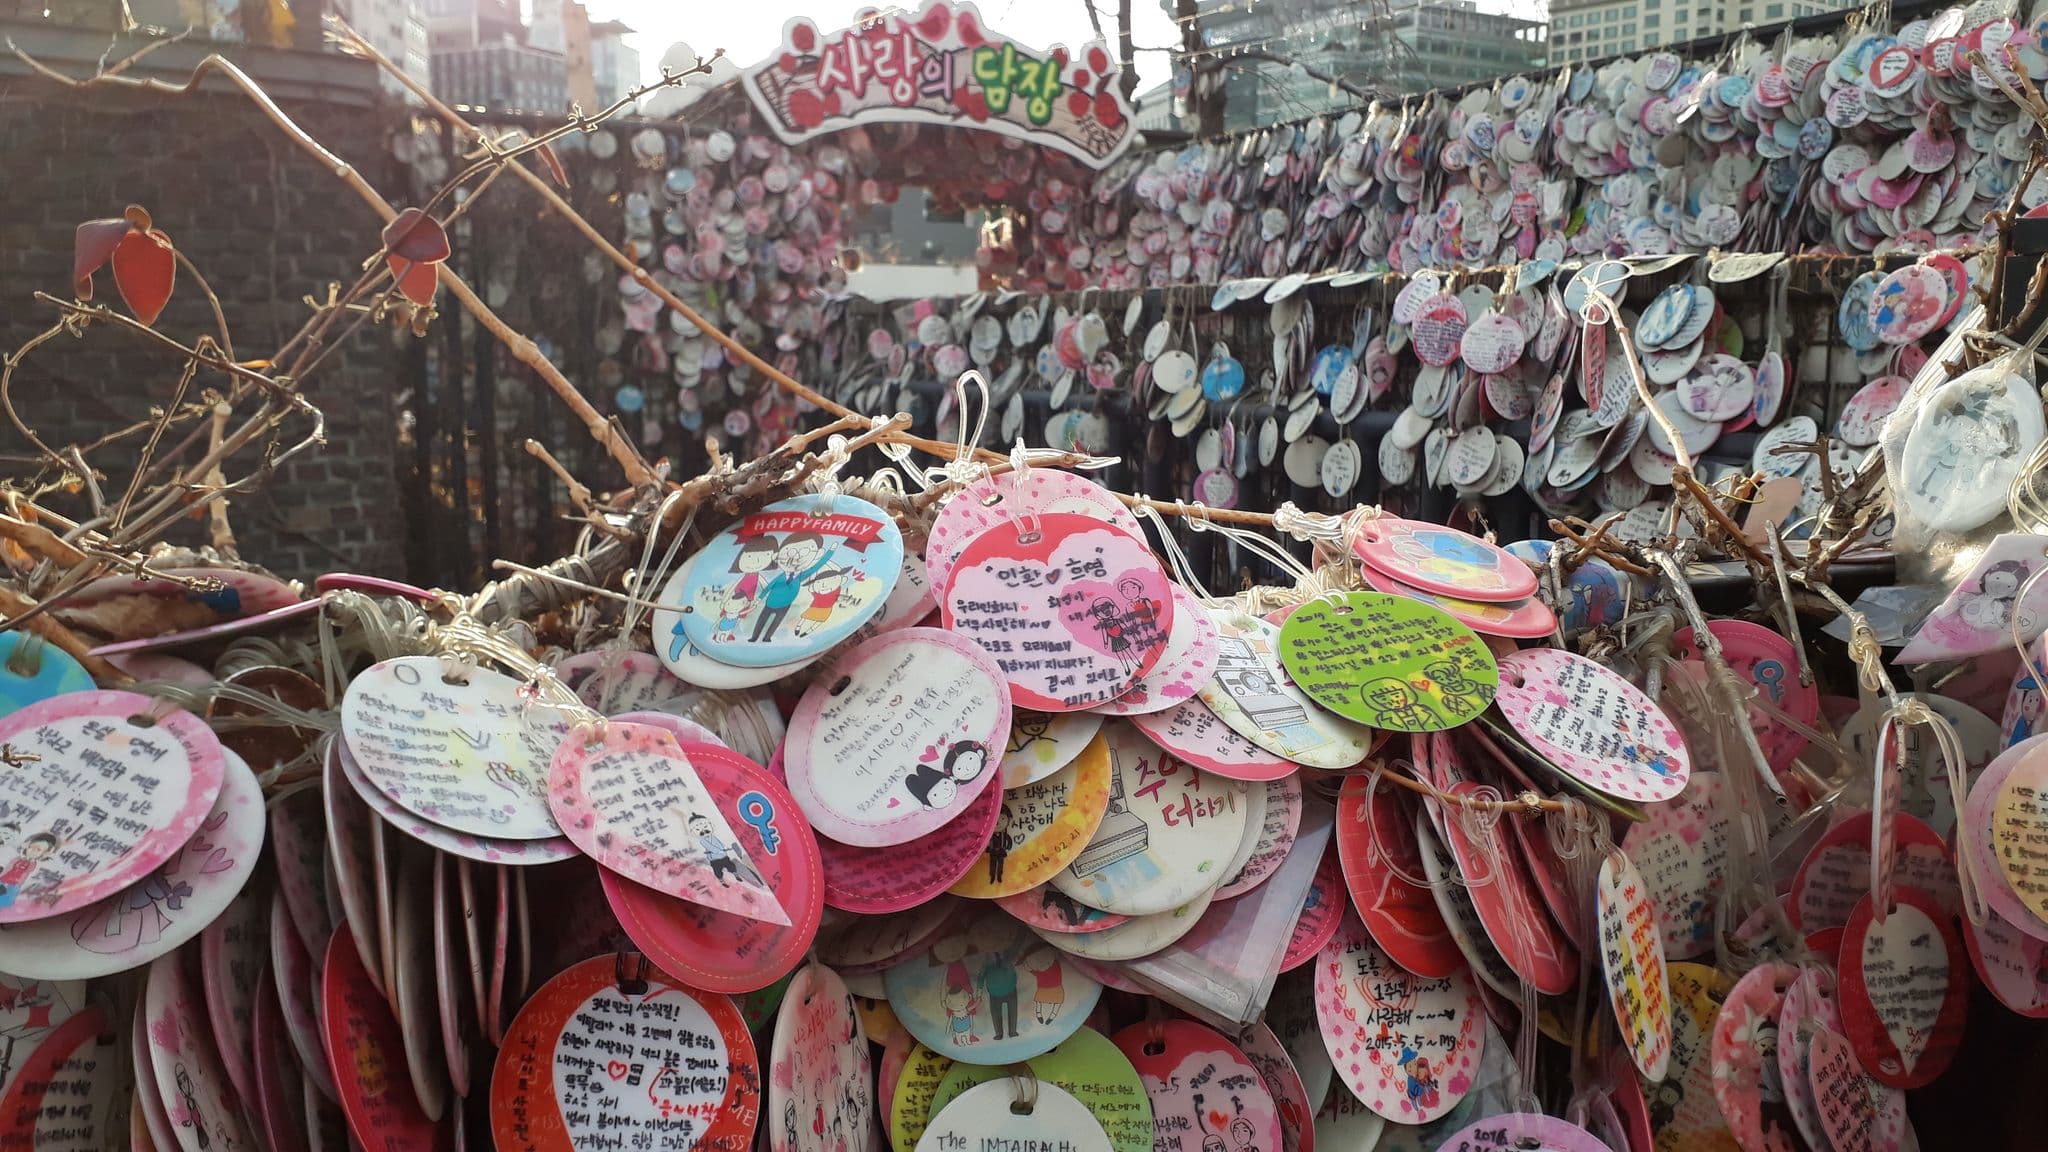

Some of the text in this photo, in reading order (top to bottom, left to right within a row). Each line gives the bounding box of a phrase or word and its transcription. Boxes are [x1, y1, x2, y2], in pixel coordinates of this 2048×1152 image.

[817, 33, 1060, 125] 사랑의 담장
[977, 637, 1013, 652] 으로도
[1161, 791, 1236, 828] 더하기
[937, 1131, 967, 1151] The
